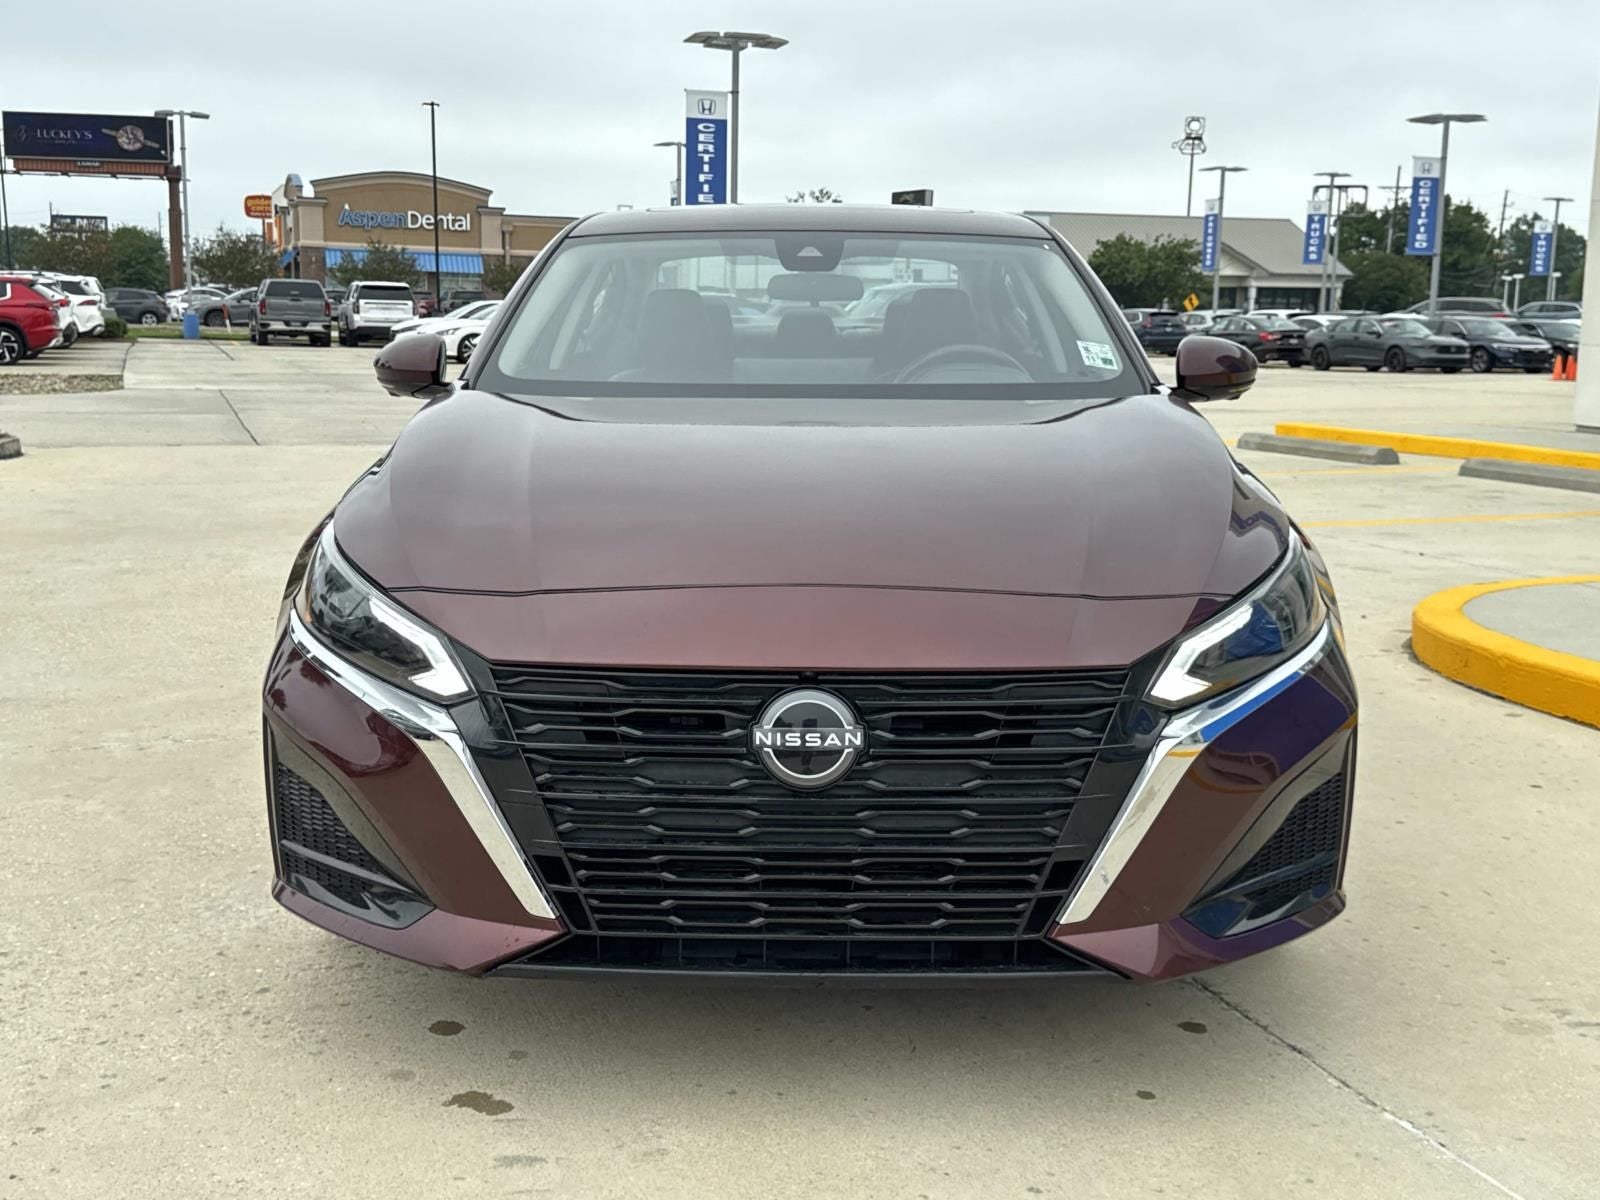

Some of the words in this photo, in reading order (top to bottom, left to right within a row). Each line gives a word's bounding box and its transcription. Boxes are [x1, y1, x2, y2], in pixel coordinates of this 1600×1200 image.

[1414, 179, 1433, 249] CERTIFIED
[1308, 215, 1321, 261] TRUCKS
[755, 731, 861, 747] NISSAN
